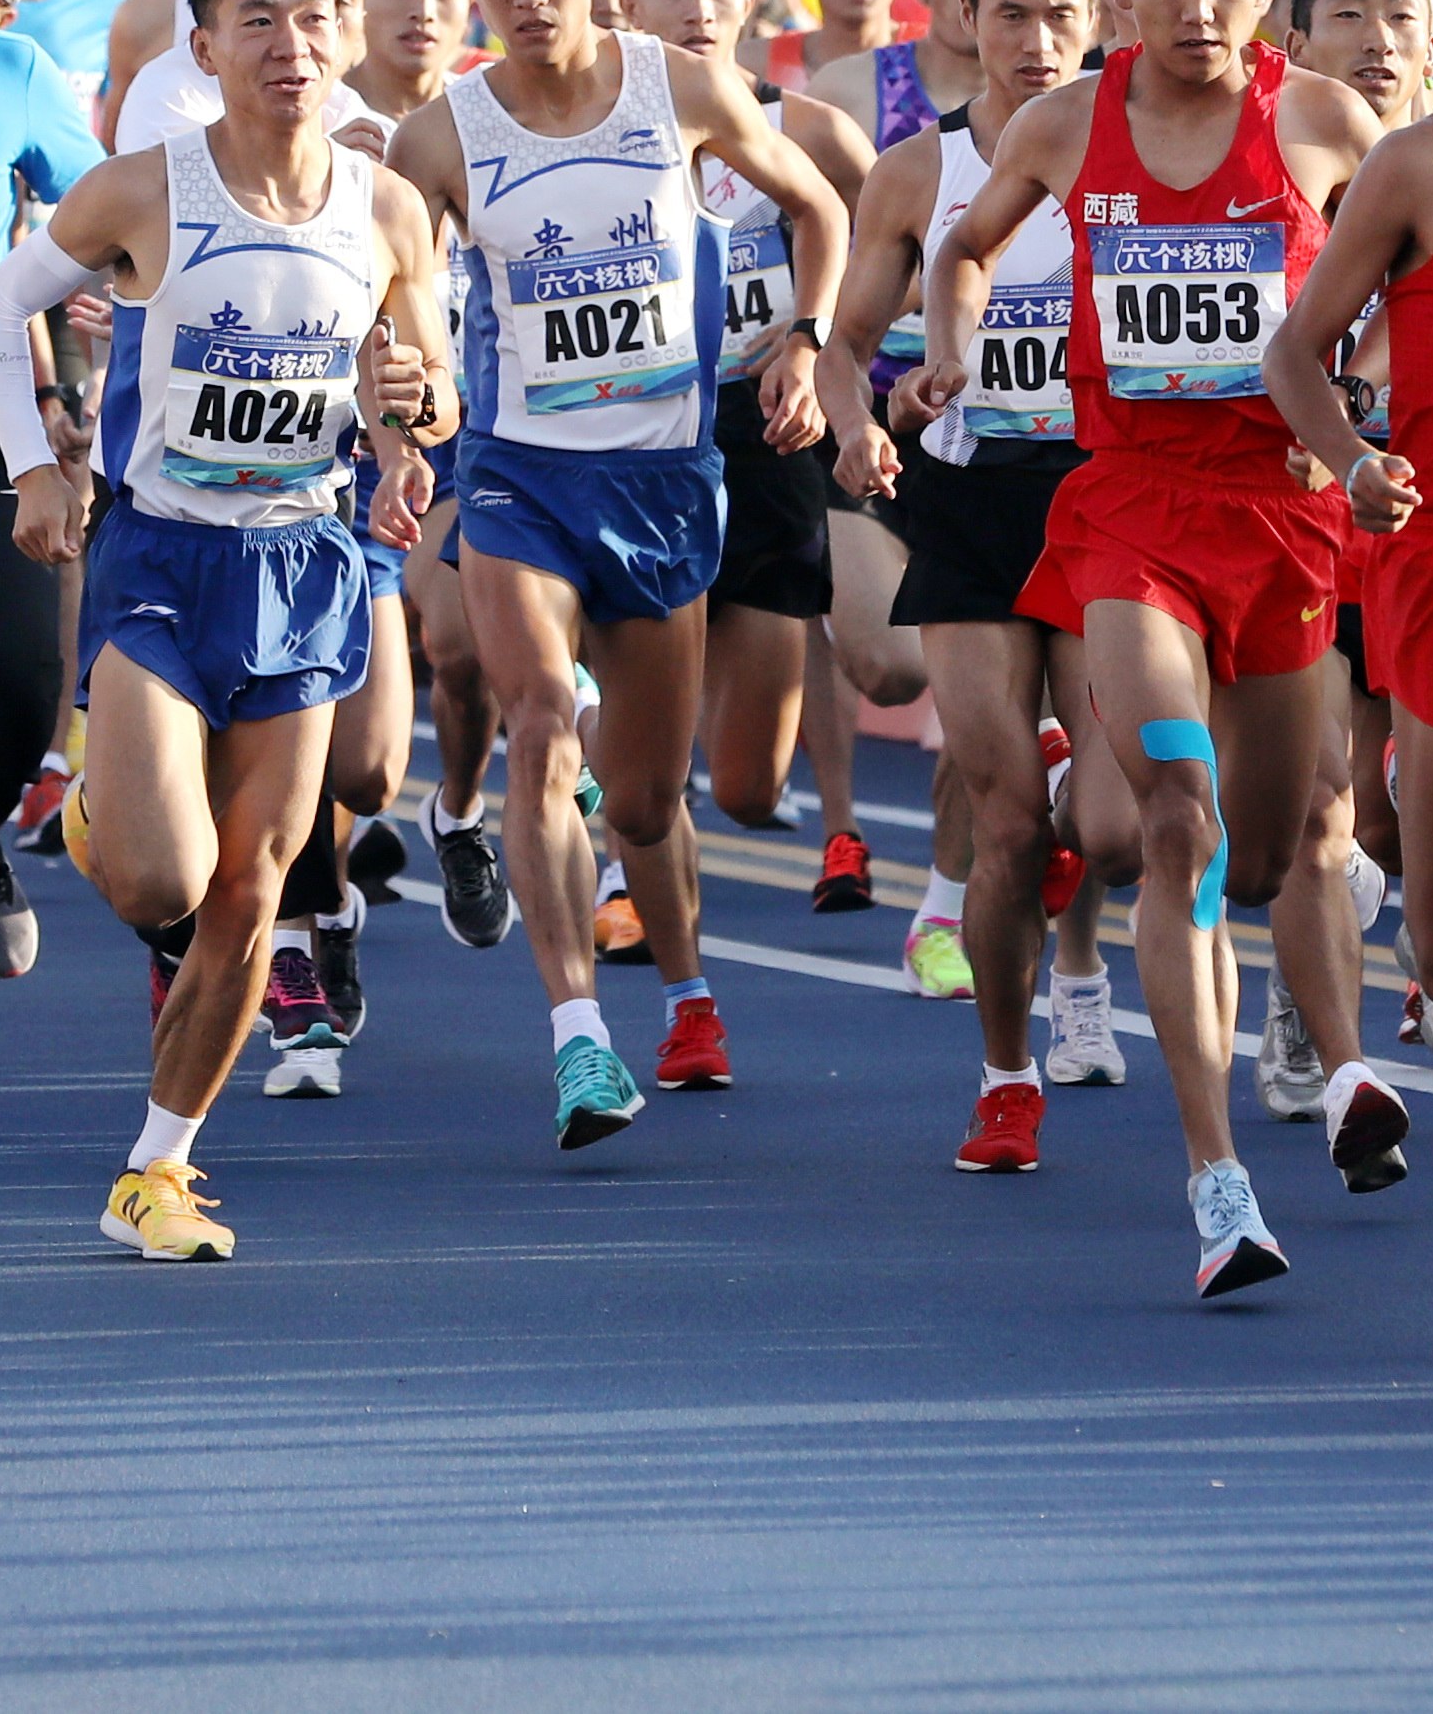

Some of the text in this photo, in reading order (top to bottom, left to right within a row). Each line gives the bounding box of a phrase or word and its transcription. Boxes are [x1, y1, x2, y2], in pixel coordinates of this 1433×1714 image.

[523, 199, 653, 260] 贵州
[1083, 191, 1139, 226] 西藏
[538, 259, 658, 299] 六个核桃
[1120, 242, 1247, 271] 六个核桃
[544, 294, 668, 364] A021
[1115, 282, 1261, 345] A053
[209, 347, 328, 379] 六个核桃
[188, 383, 328, 444] A024
